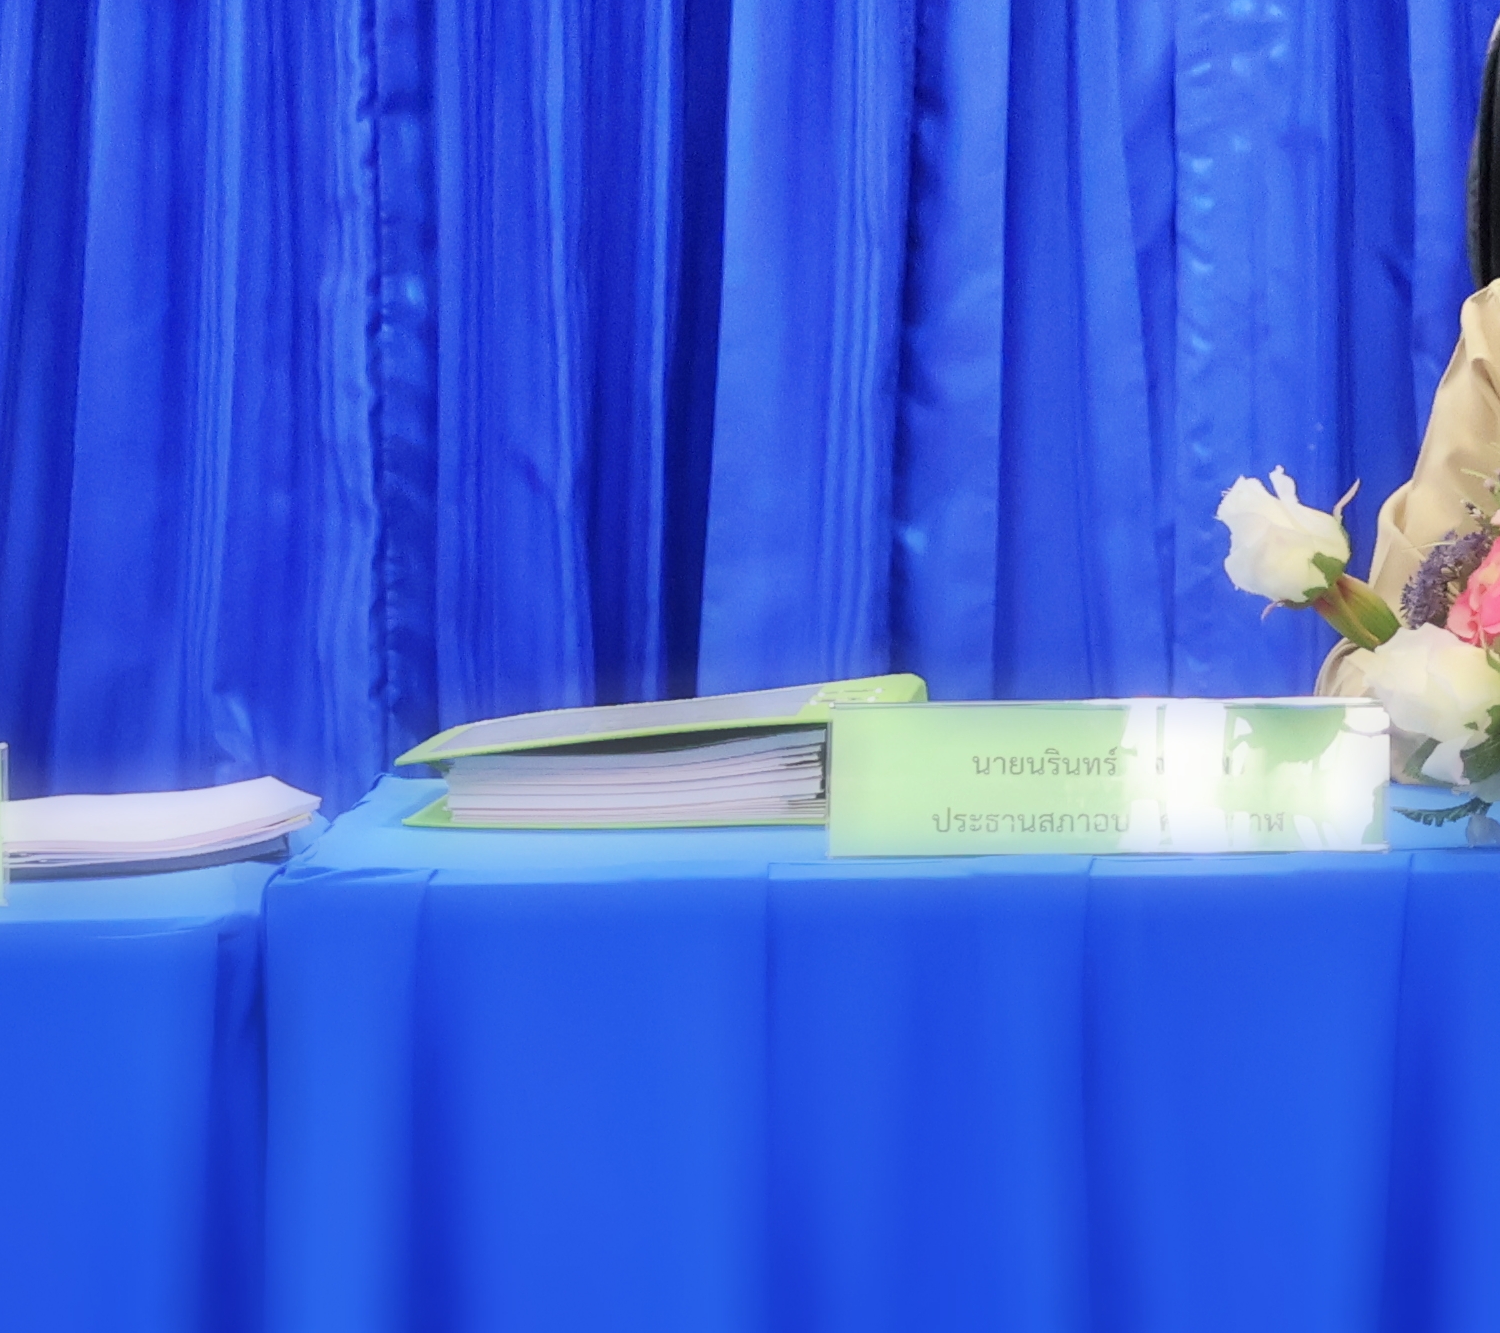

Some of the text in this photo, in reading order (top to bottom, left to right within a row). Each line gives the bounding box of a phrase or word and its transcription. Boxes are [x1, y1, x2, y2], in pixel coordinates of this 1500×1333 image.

[972, 745, 1119, 777] นายนรินทร์
[931, 806, 1286, 834] ประธานสภาอบาฬ
